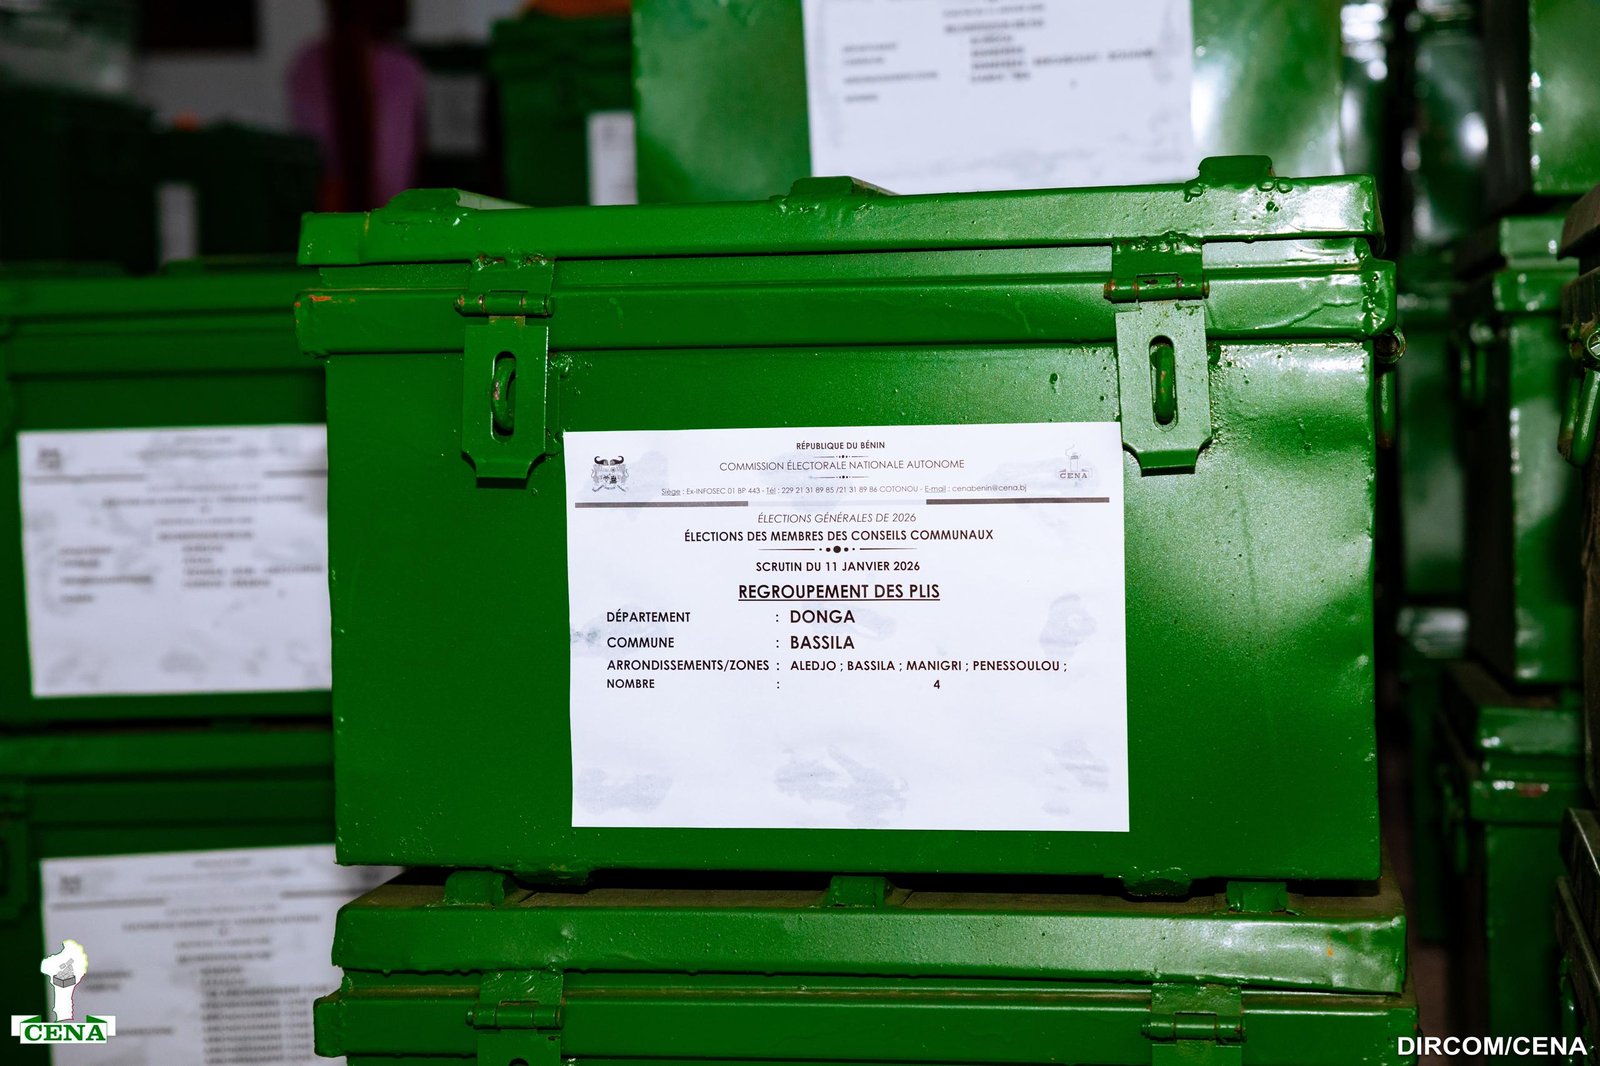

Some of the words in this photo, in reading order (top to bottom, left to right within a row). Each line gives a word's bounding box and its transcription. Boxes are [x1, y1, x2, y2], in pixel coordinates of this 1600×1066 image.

[796, 440, 844, 450] RÉPUBLIQUE
[846, 441, 858, 450] DU
[860, 440, 885, 449] BÉNIN
[719, 461, 784, 471] COMMISSION
[786, 459, 846, 471] ÉLECTORALE
[849, 460, 904, 470] NATIONALE
[906, 459, 965, 469] AUTONOME
[661, 487, 681, 496] Siège
[686, 487, 726, 496] Ex-INFOSEC
[737, 487, 746, 495] BP
[748, 487, 761, 495] 443
[766, 487, 777, 496] Tél
[782, 486, 794, 494] 229
[795, 486, 804, 494] 21
[805, 486, 813, 494] 31
[815, 486, 824, 494] 89
[826, 486, 835, 494] 85
[848, 485, 857, 493] 31
[859, 485, 868, 493] 89
[869, 485, 878, 493] 86
[880, 485, 918, 493] COTONOU
[924, 485, 946, 493] E-mail
[952, 484, 1027, 494] cenabenin@cena.bj
[757, 511, 812, 524] ÉLECTIONS
[814, 511, 873, 524] GÉNÉRALES
[876, 513, 890, 523] DE
[892, 512, 917, 523] 2026
[685, 529, 744, 542] ÉLECTIONS
[747, 531, 767, 542] DES
[771, 531, 824, 542] MEMBRES
[827, 530, 848, 541] DES
[851, 530, 907, 541] CONSEILS
[910, 529, 993, 541] COMMUNAUX
[756, 561, 803, 572] SCRUTIN
[806, 561, 822, 572] DU
[825, 561, 837, 572] 11
[842, 561, 889, 572] JANVIER
[894, 560, 921, 571] 2026
[738, 584, 870, 600] REGROUPEMENT
[874, 584, 906, 600] DES
[908, 584, 940, 600] PLIS
[607, 609, 691, 623] DÉPARTEMENT
[790, 609, 856, 624] DONGA
[607, 636, 675, 649] COMMUNE
[790, 635, 855, 649] BASSILA
[607, 659, 770, 672] ARRONDISSEMENTS/ZONES
[790, 660, 837, 672] ALEDJO
[847, 660, 896, 672] BASSILA
[906, 660, 962, 672] MANIGRI
[973, 660, 1060, 672] PENESSOULOU
[607, 678, 656, 689] NOMBRE
[933, 680, 941, 690] 4
